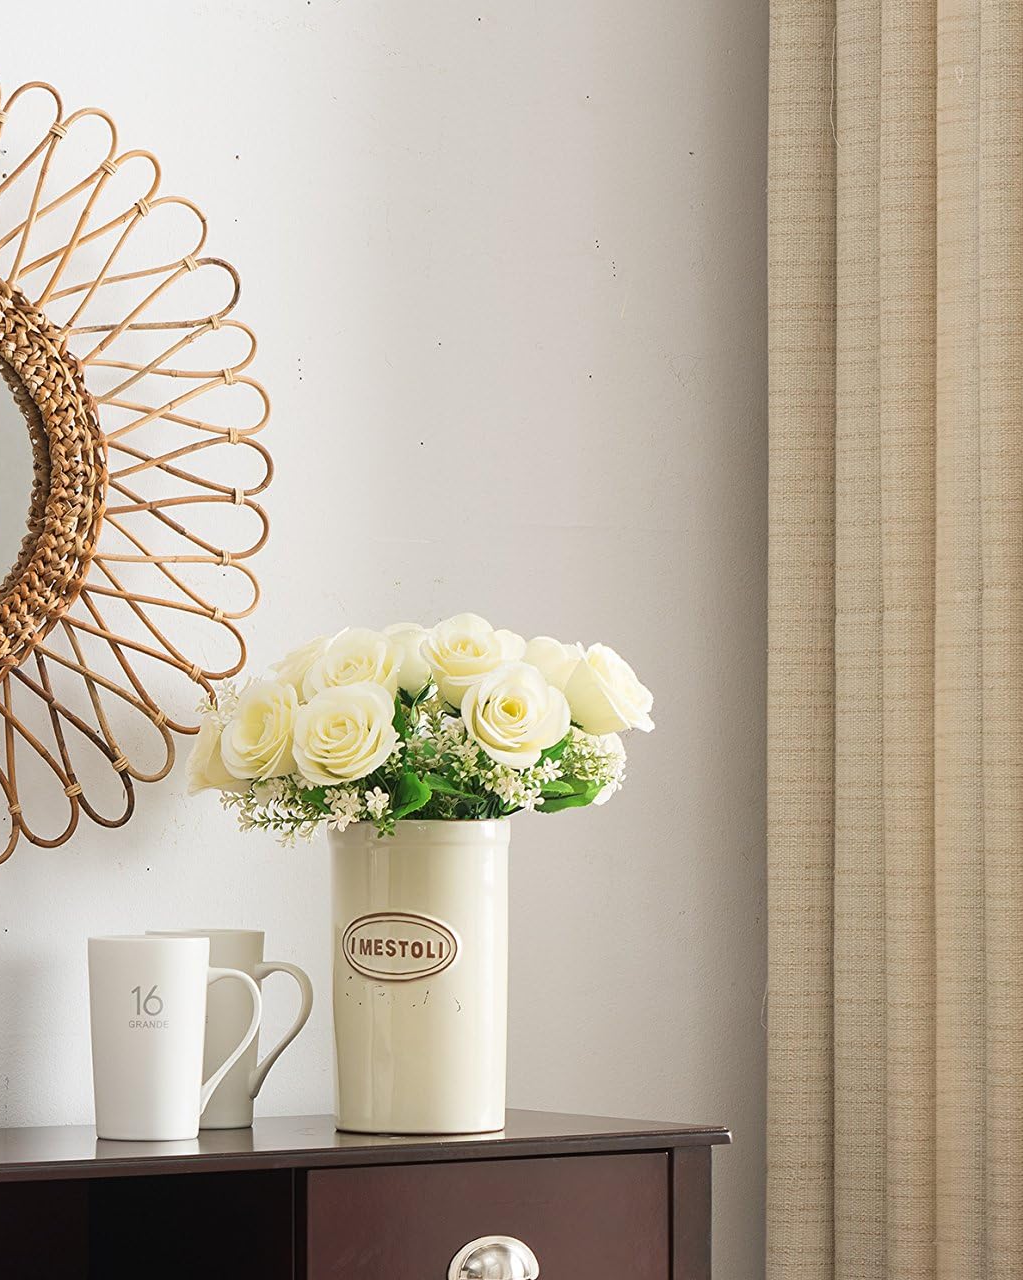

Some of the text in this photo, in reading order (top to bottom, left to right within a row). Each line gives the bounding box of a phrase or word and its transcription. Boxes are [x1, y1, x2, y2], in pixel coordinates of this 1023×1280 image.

[351, 937, 444, 959] I MESTOLI
[131, 984, 164, 1016] 16
[128, 1019, 170, 1029] GRANDE
